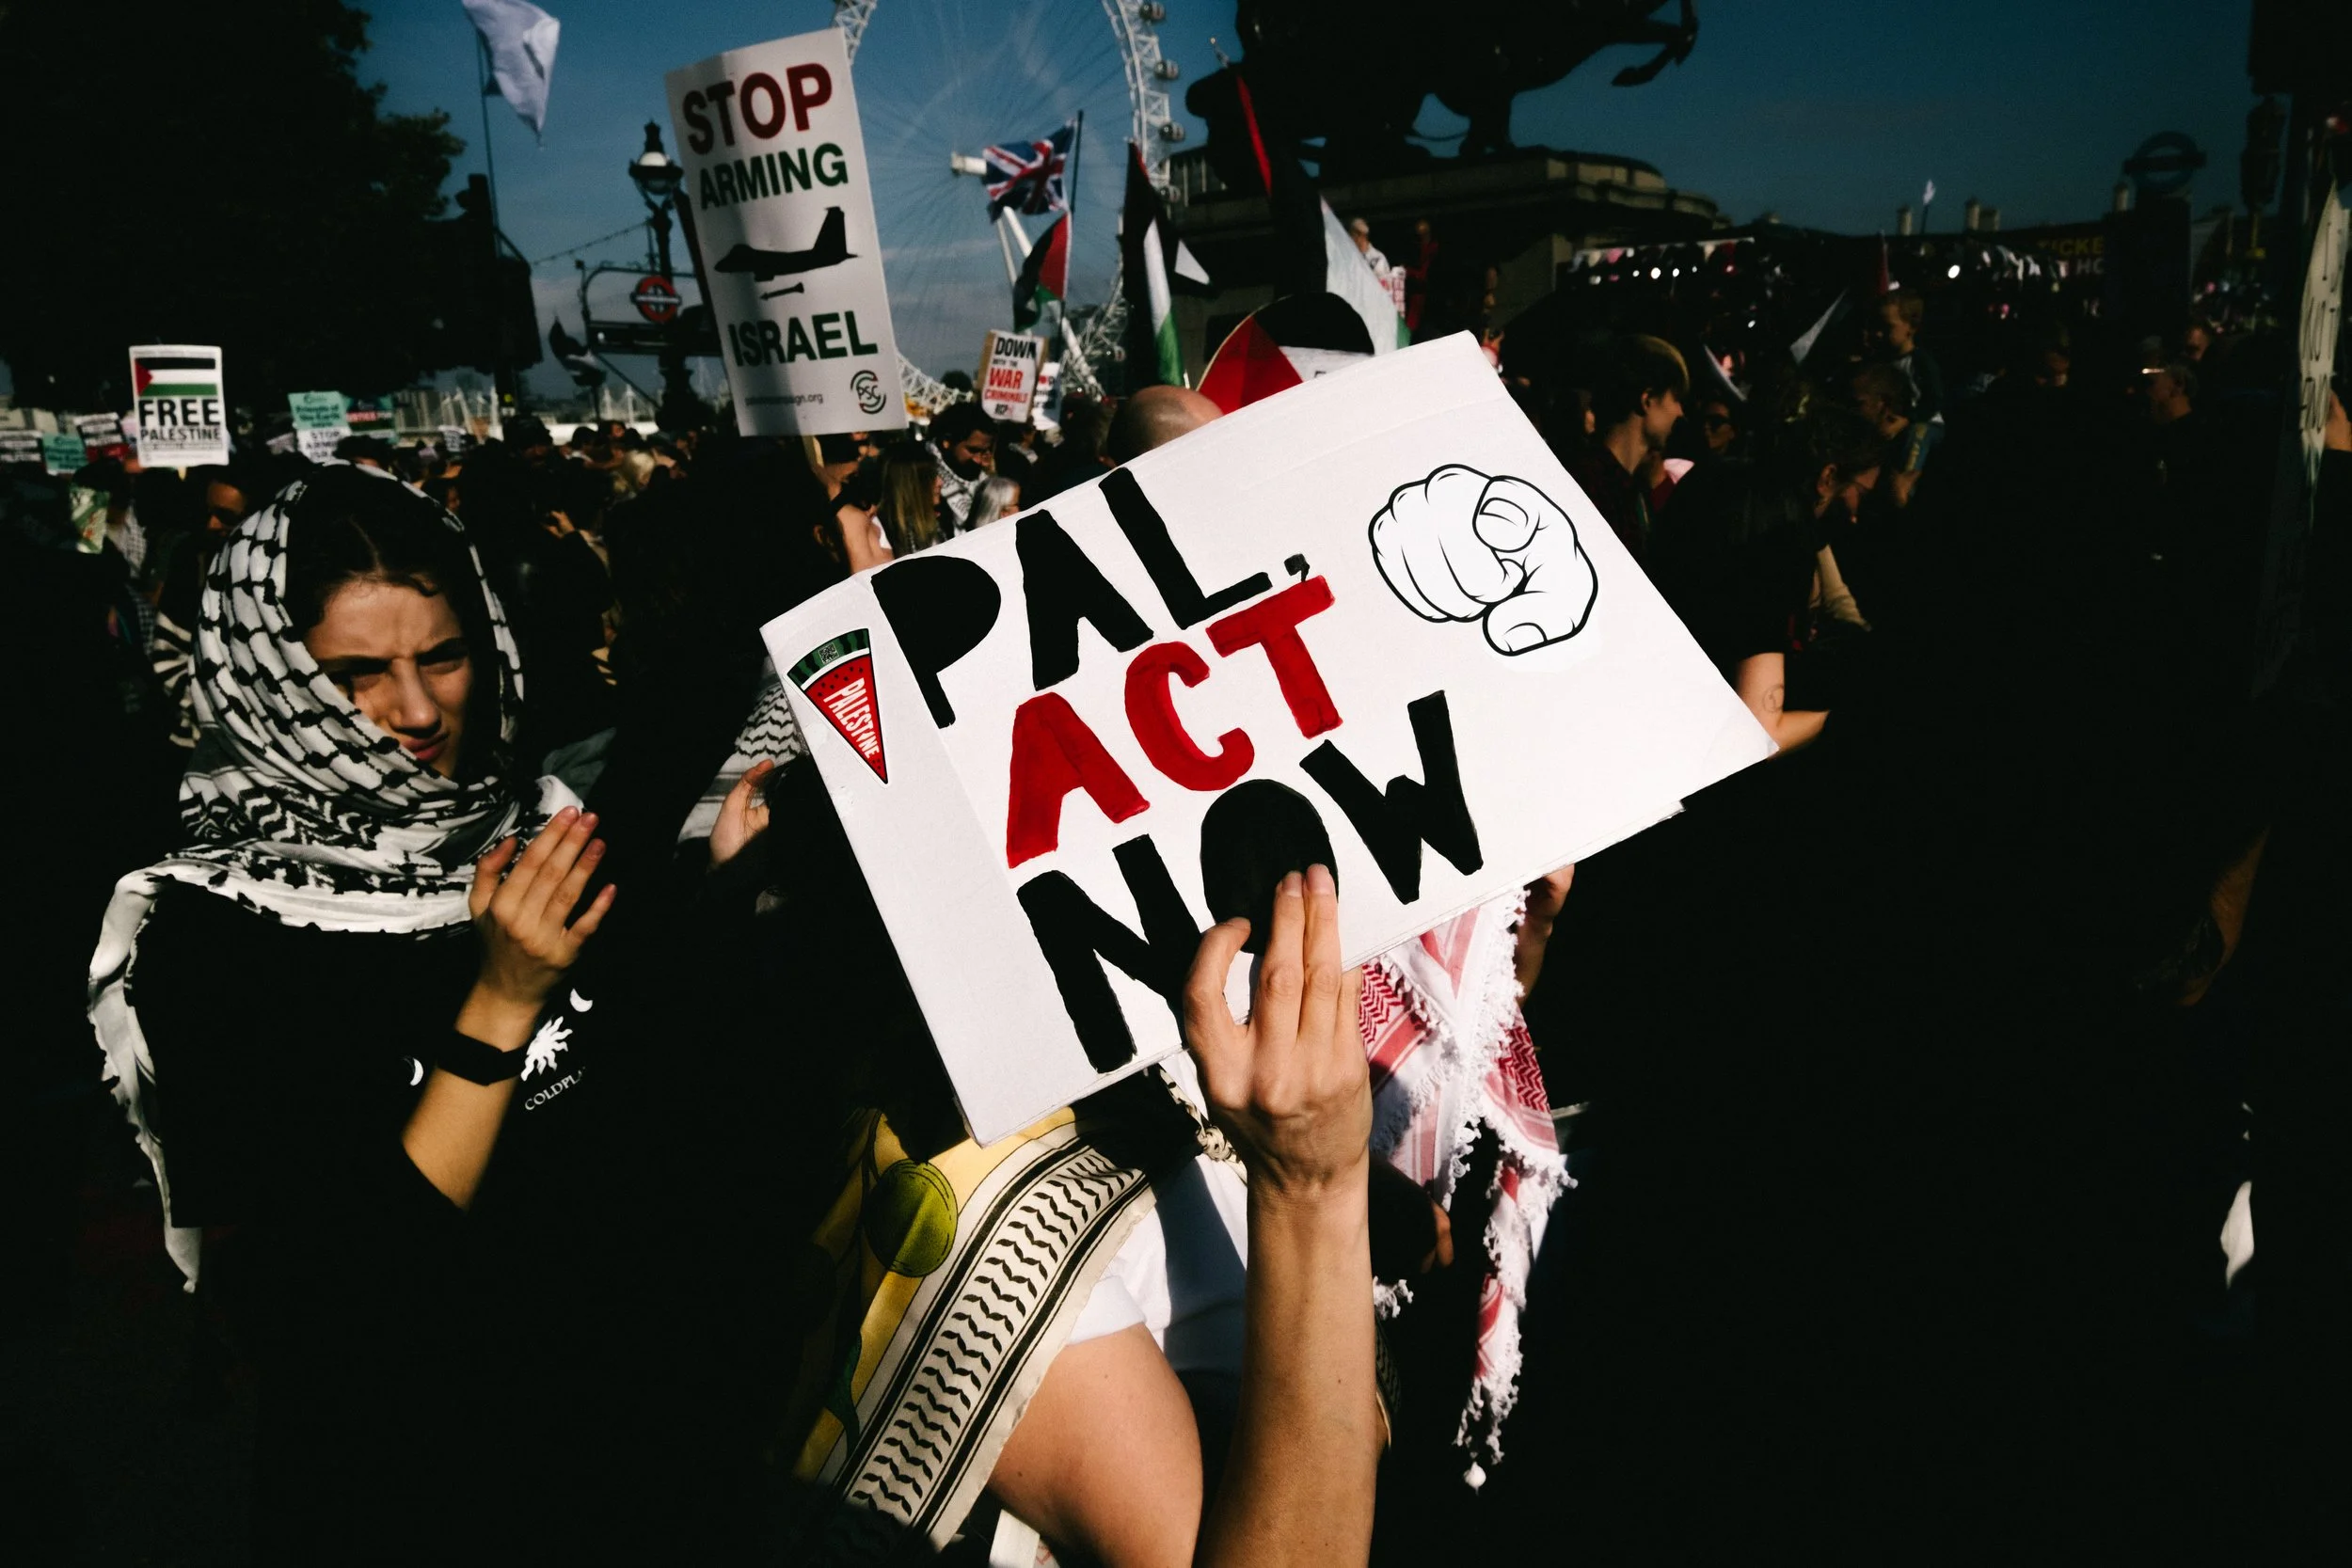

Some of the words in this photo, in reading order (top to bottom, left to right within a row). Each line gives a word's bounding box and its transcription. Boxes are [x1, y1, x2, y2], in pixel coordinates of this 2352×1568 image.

[682, 63, 833, 154] STOP
[699, 143, 848, 210] ARMING
[2036, 236, 2105, 255] TICKE
[727, 310, 878, 368] ISRAEL
[995, 337, 1037, 358] DOWN
[990, 368, 1024, 389] WAR
[138, 399, 220, 426] FREE
[140, 428, 220, 441] PALESTINE
[871, 467, 1309, 729] PAL,
[822, 677, 881, 759] PALESTINE
[1007, 575, 1343, 868] ACT
[1017, 690, 1483, 1073] NOW
[524, 1067, 586, 1111] COLDPL
